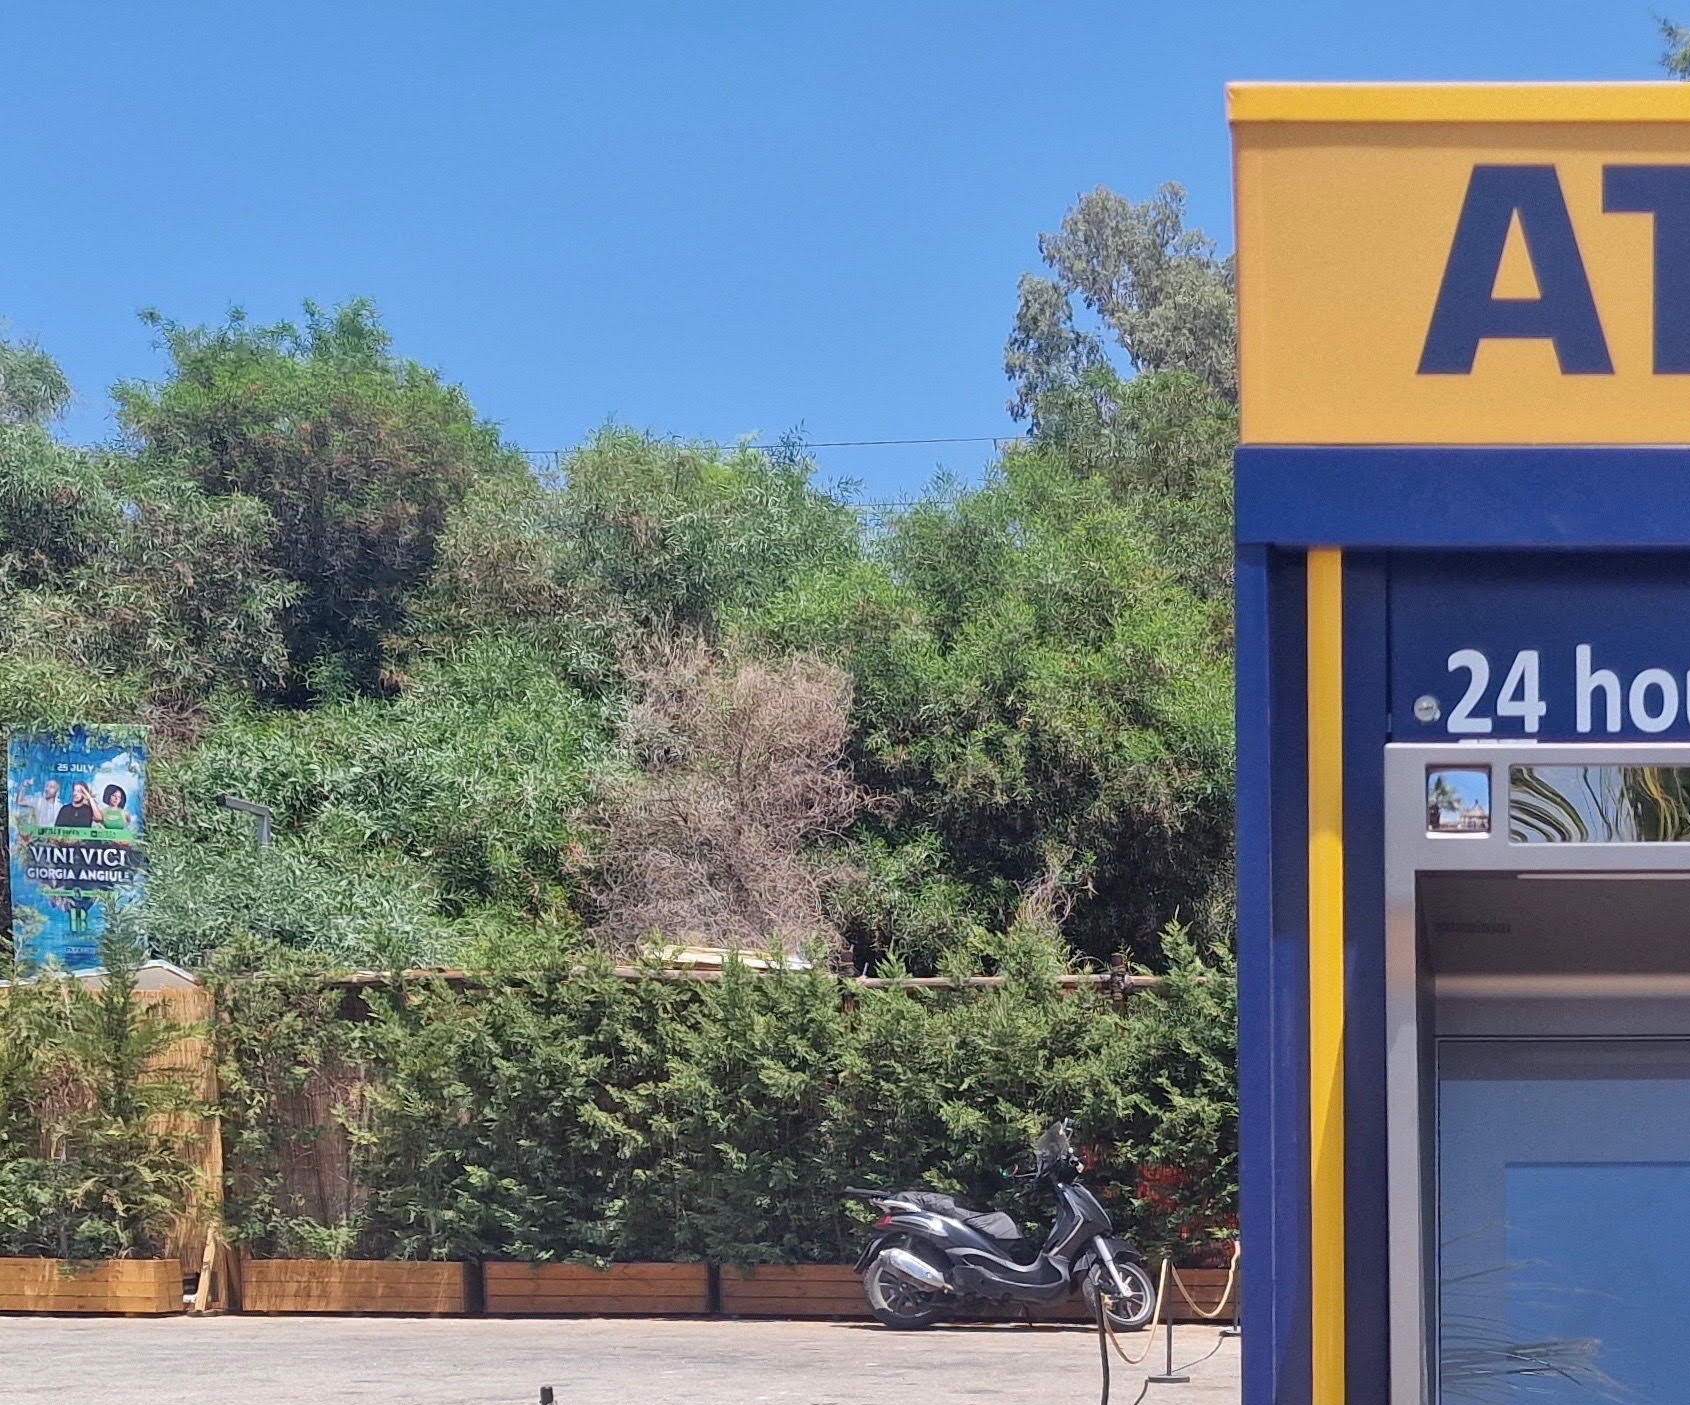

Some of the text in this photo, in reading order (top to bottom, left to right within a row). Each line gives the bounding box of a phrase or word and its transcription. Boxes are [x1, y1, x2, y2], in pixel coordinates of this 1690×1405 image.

[1446, 648, 1547, 734] 24
[57, 763, 95, 773] 25 JULY
[30, 846, 127, 867] VINI VICI
[27, 867, 76, 880] GIORGIA
